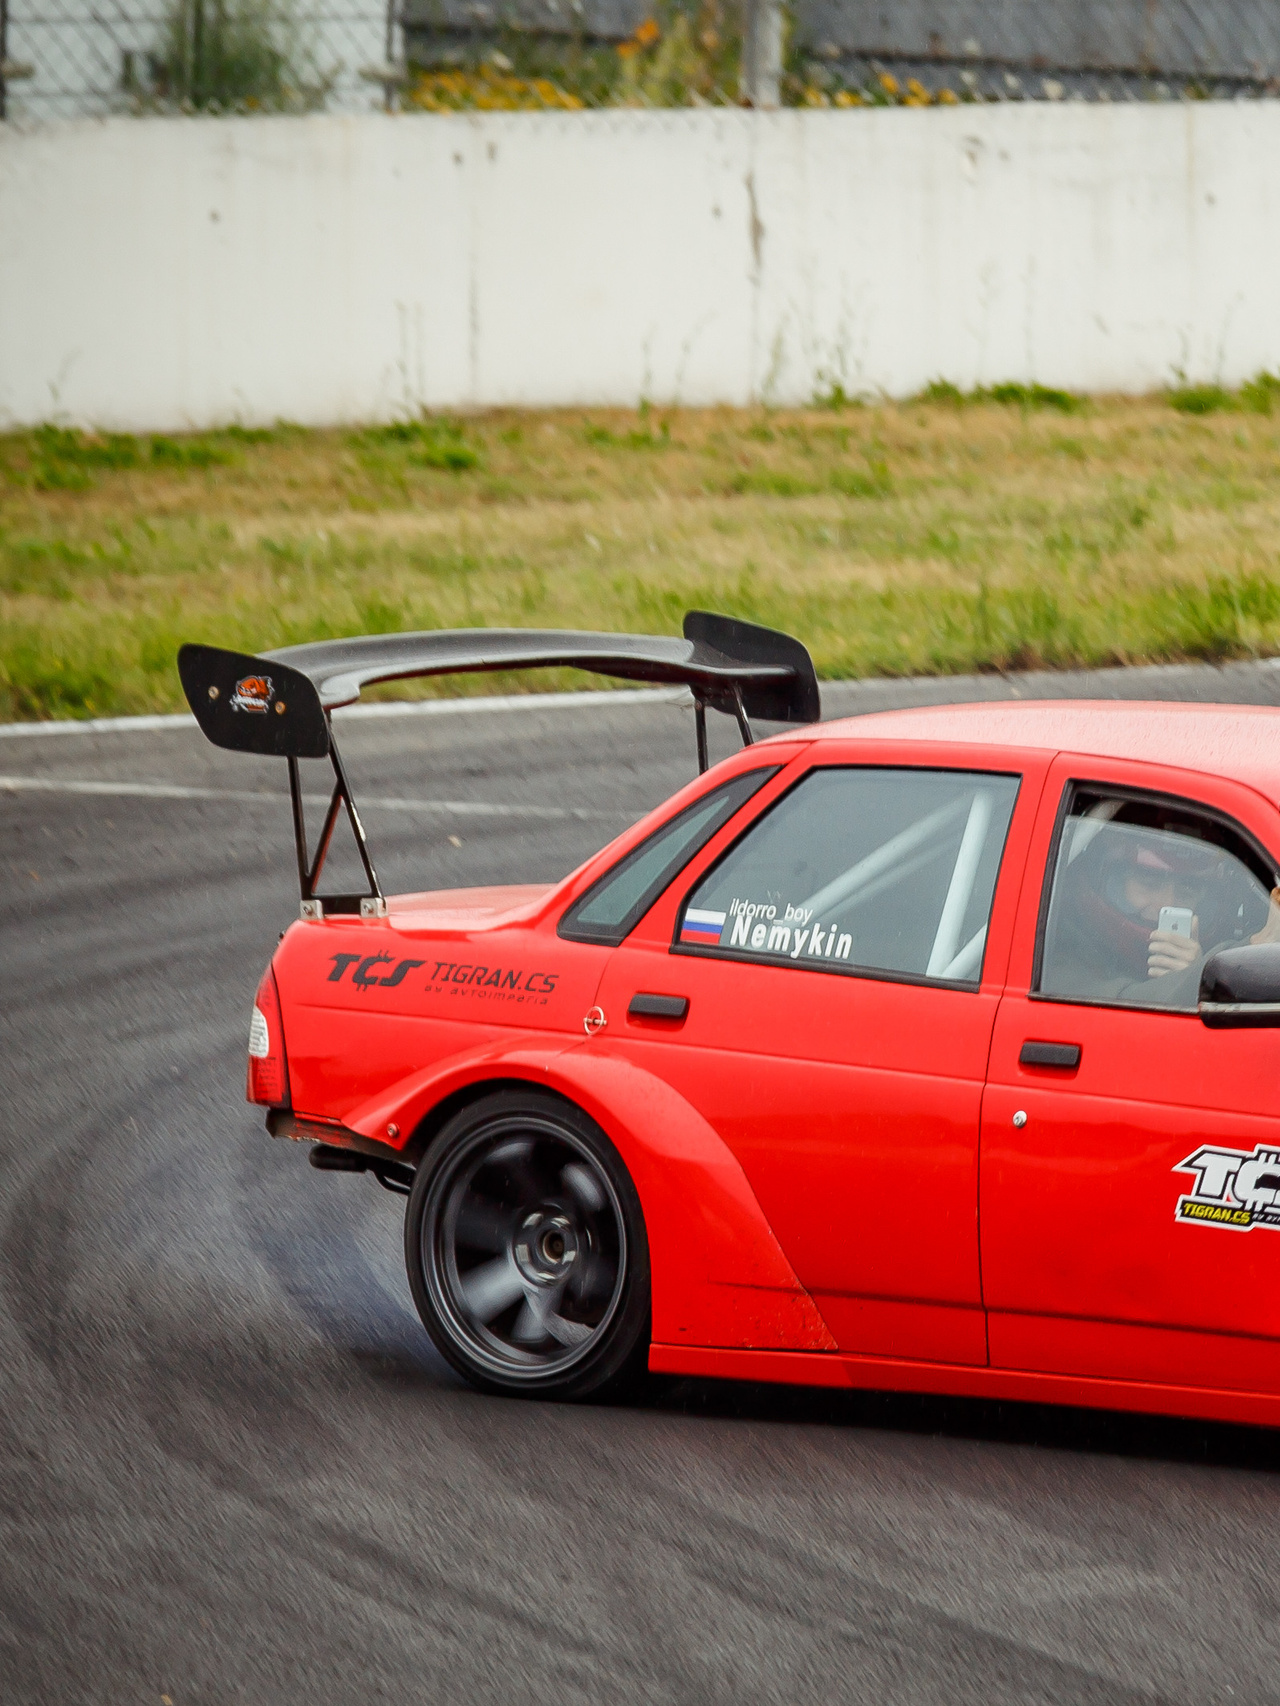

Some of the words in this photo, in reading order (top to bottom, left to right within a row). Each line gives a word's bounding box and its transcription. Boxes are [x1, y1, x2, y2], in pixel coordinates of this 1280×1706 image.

[729, 914, 853, 959] Nemykin
[327, 950, 427, 992] TCS
[431, 961, 559, 993] TIGRAN.CS
[1183, 1202, 1251, 1225] TIGRAN.CS
